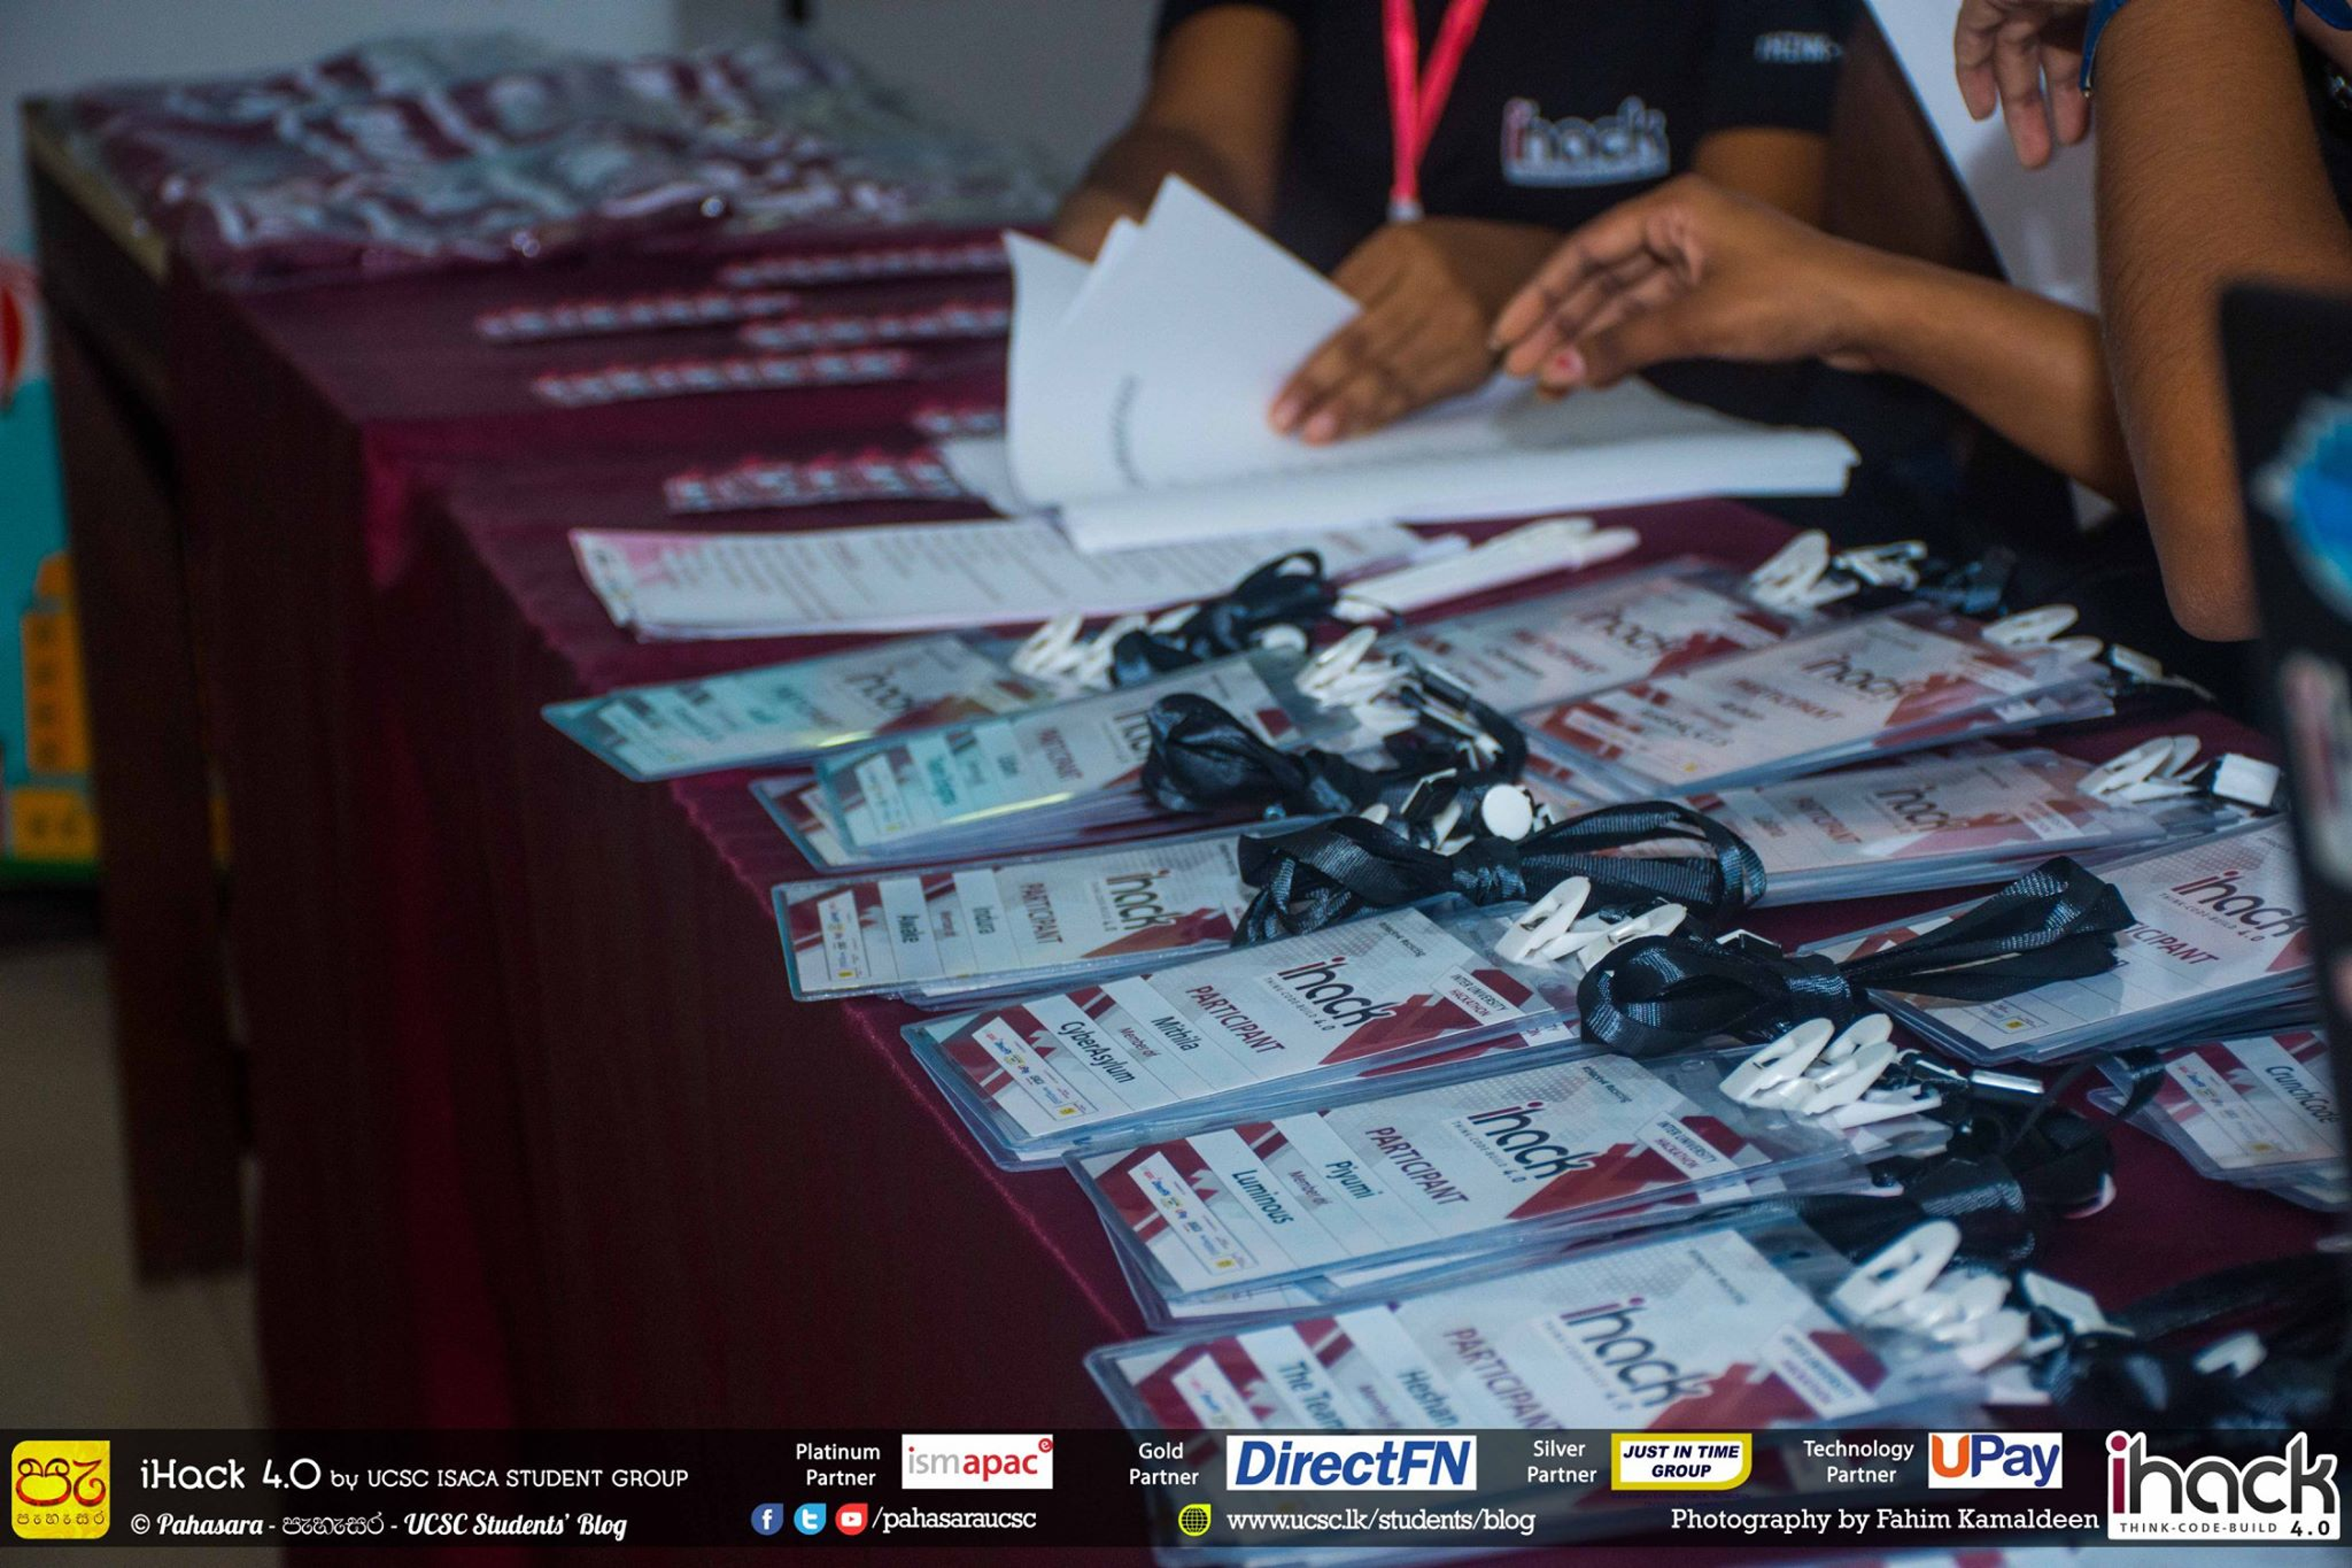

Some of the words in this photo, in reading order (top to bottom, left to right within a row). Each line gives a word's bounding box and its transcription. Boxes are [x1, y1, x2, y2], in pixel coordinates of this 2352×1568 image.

[2122, 920, 2220, 964] TICIPANT
[1185, 984, 1287, 1055] PARTICIPANT
[1057, 1020, 1136, 1084] CyberAsylum
[1325, 1159, 1383, 1200] Piyumi
[1365, 1126, 1469, 1205] PARTICIPANT
[1231, 1169, 1294, 1225] Luminous
[1278, 1360, 1315, 1394] The
[1398, 1368, 1460, 1429] Heshan
